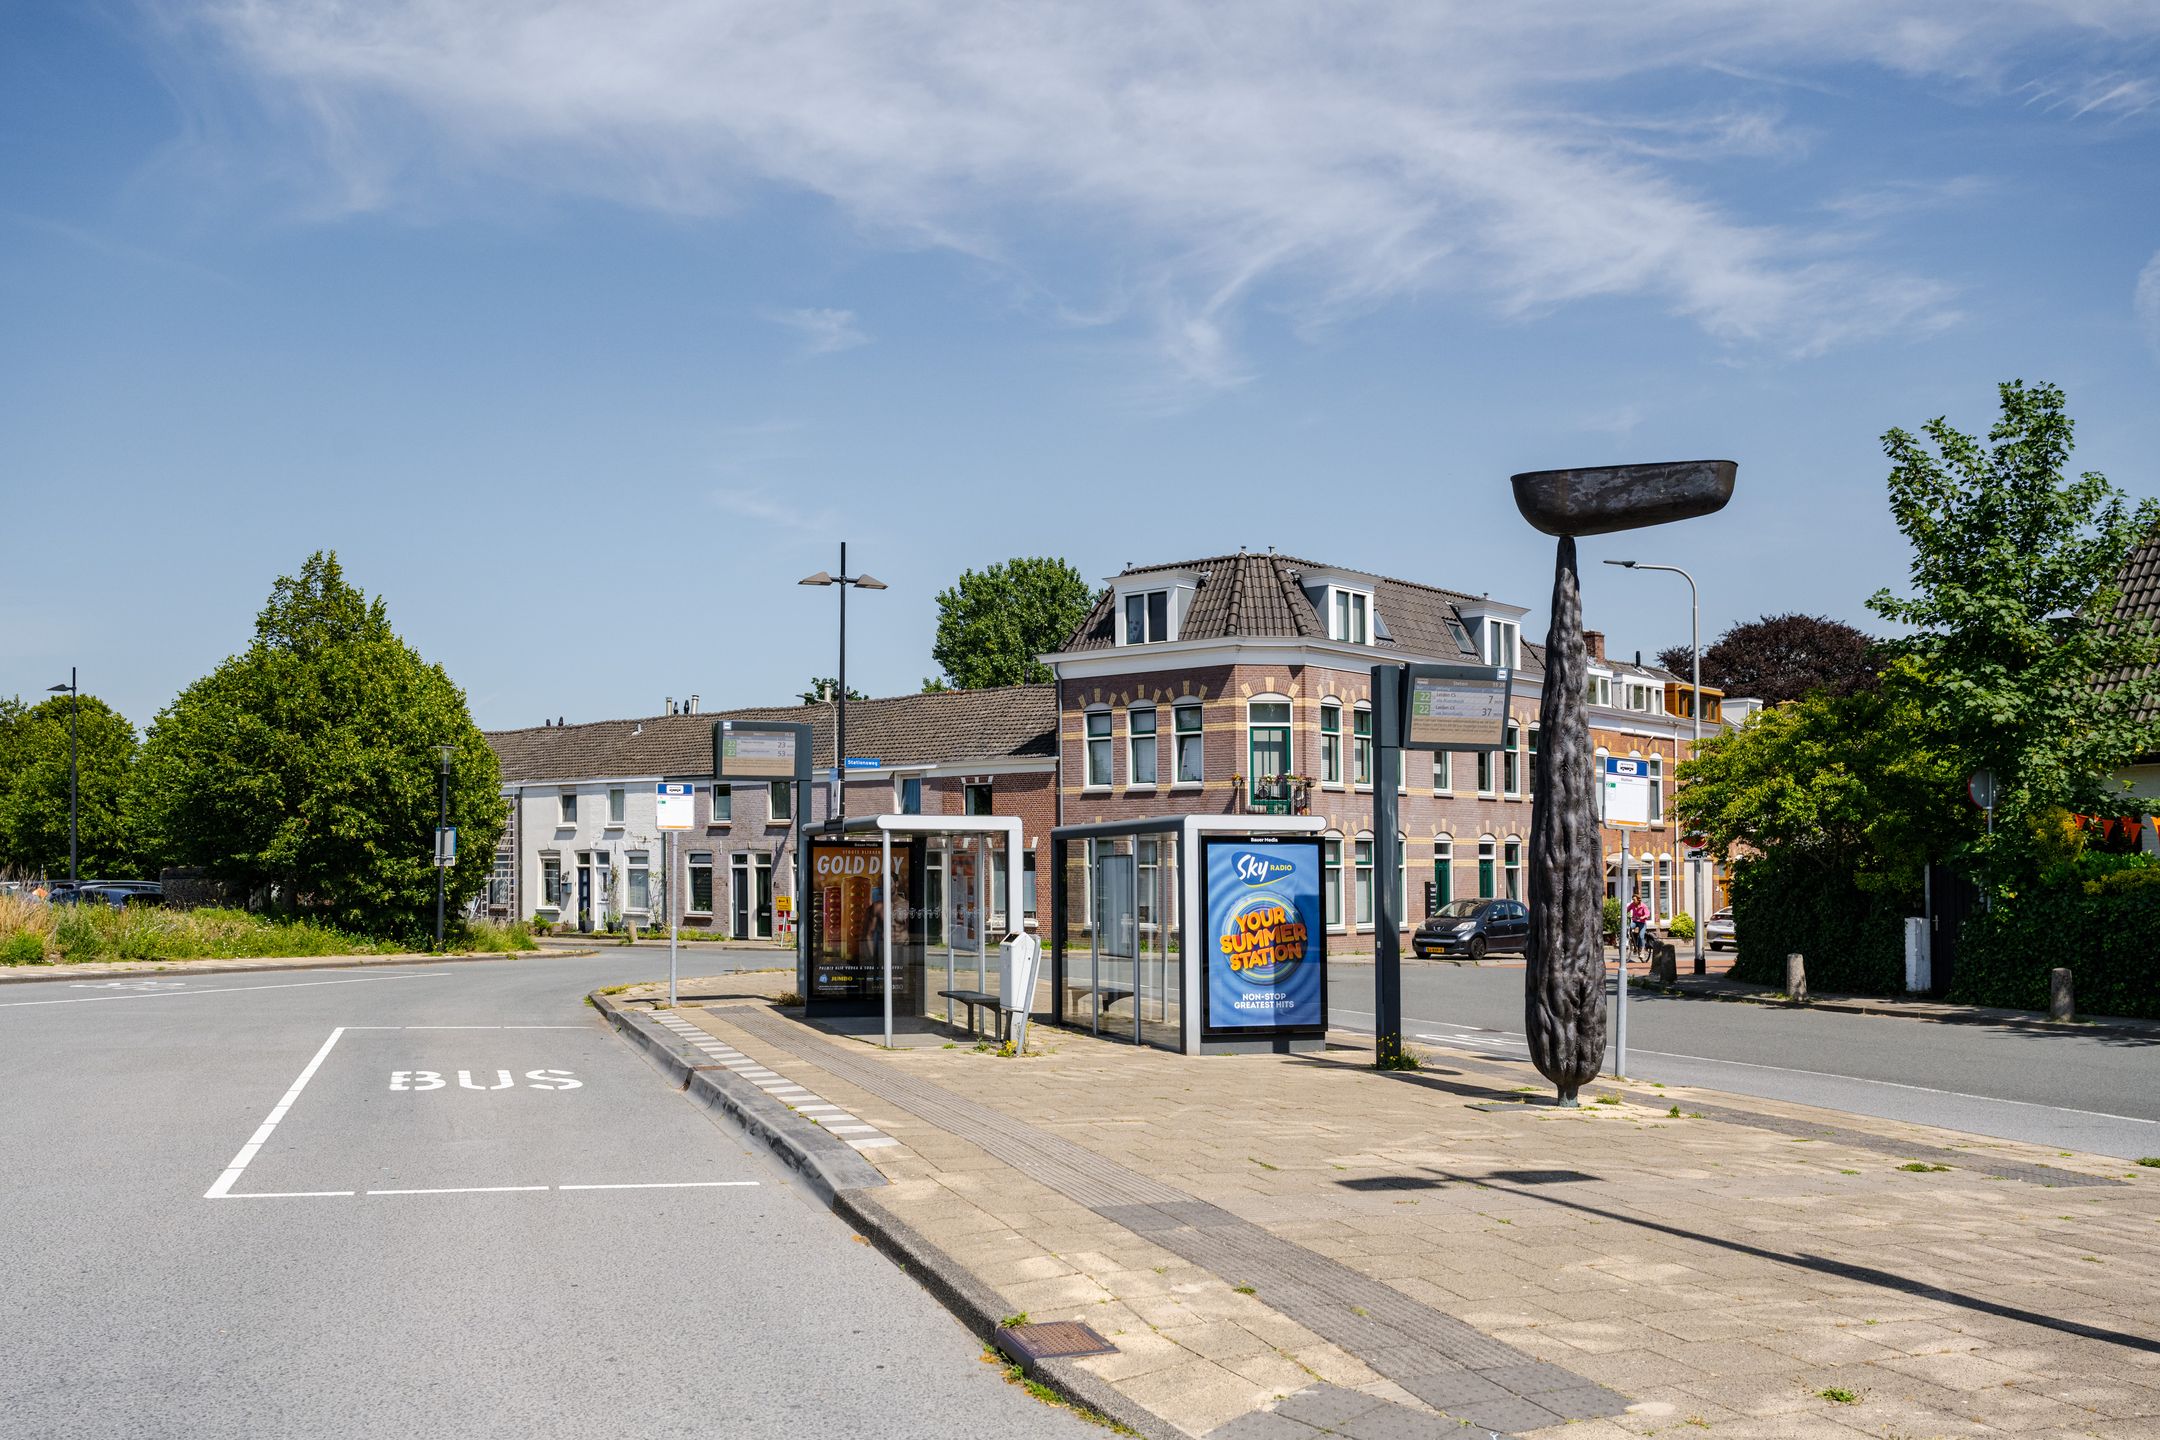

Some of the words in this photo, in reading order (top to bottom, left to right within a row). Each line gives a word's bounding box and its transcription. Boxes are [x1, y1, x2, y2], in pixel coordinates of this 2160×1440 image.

[1419, 692, 1431, 701] 22
[1488, 695, 1494, 704] 7
[1419, 704, 1430, 714] 22
[1481, 708, 1493, 717] 37
[817, 855, 865, 875] GOLD
[868, 856, 905, 875] DY
[1237, 854, 1269, 882] Sky
[1235, 906, 1286, 933] YOUR
[1220, 923, 1308, 954] SUMMER
[1229, 943, 1302, 971] STATION
[1234, 1001, 1275, 1009] GREATEST
[1276, 1000, 1295, 1008] HITS
[1242, 993, 1287, 1001] NON-STOP
[389, 1069, 584, 1091] BUS
